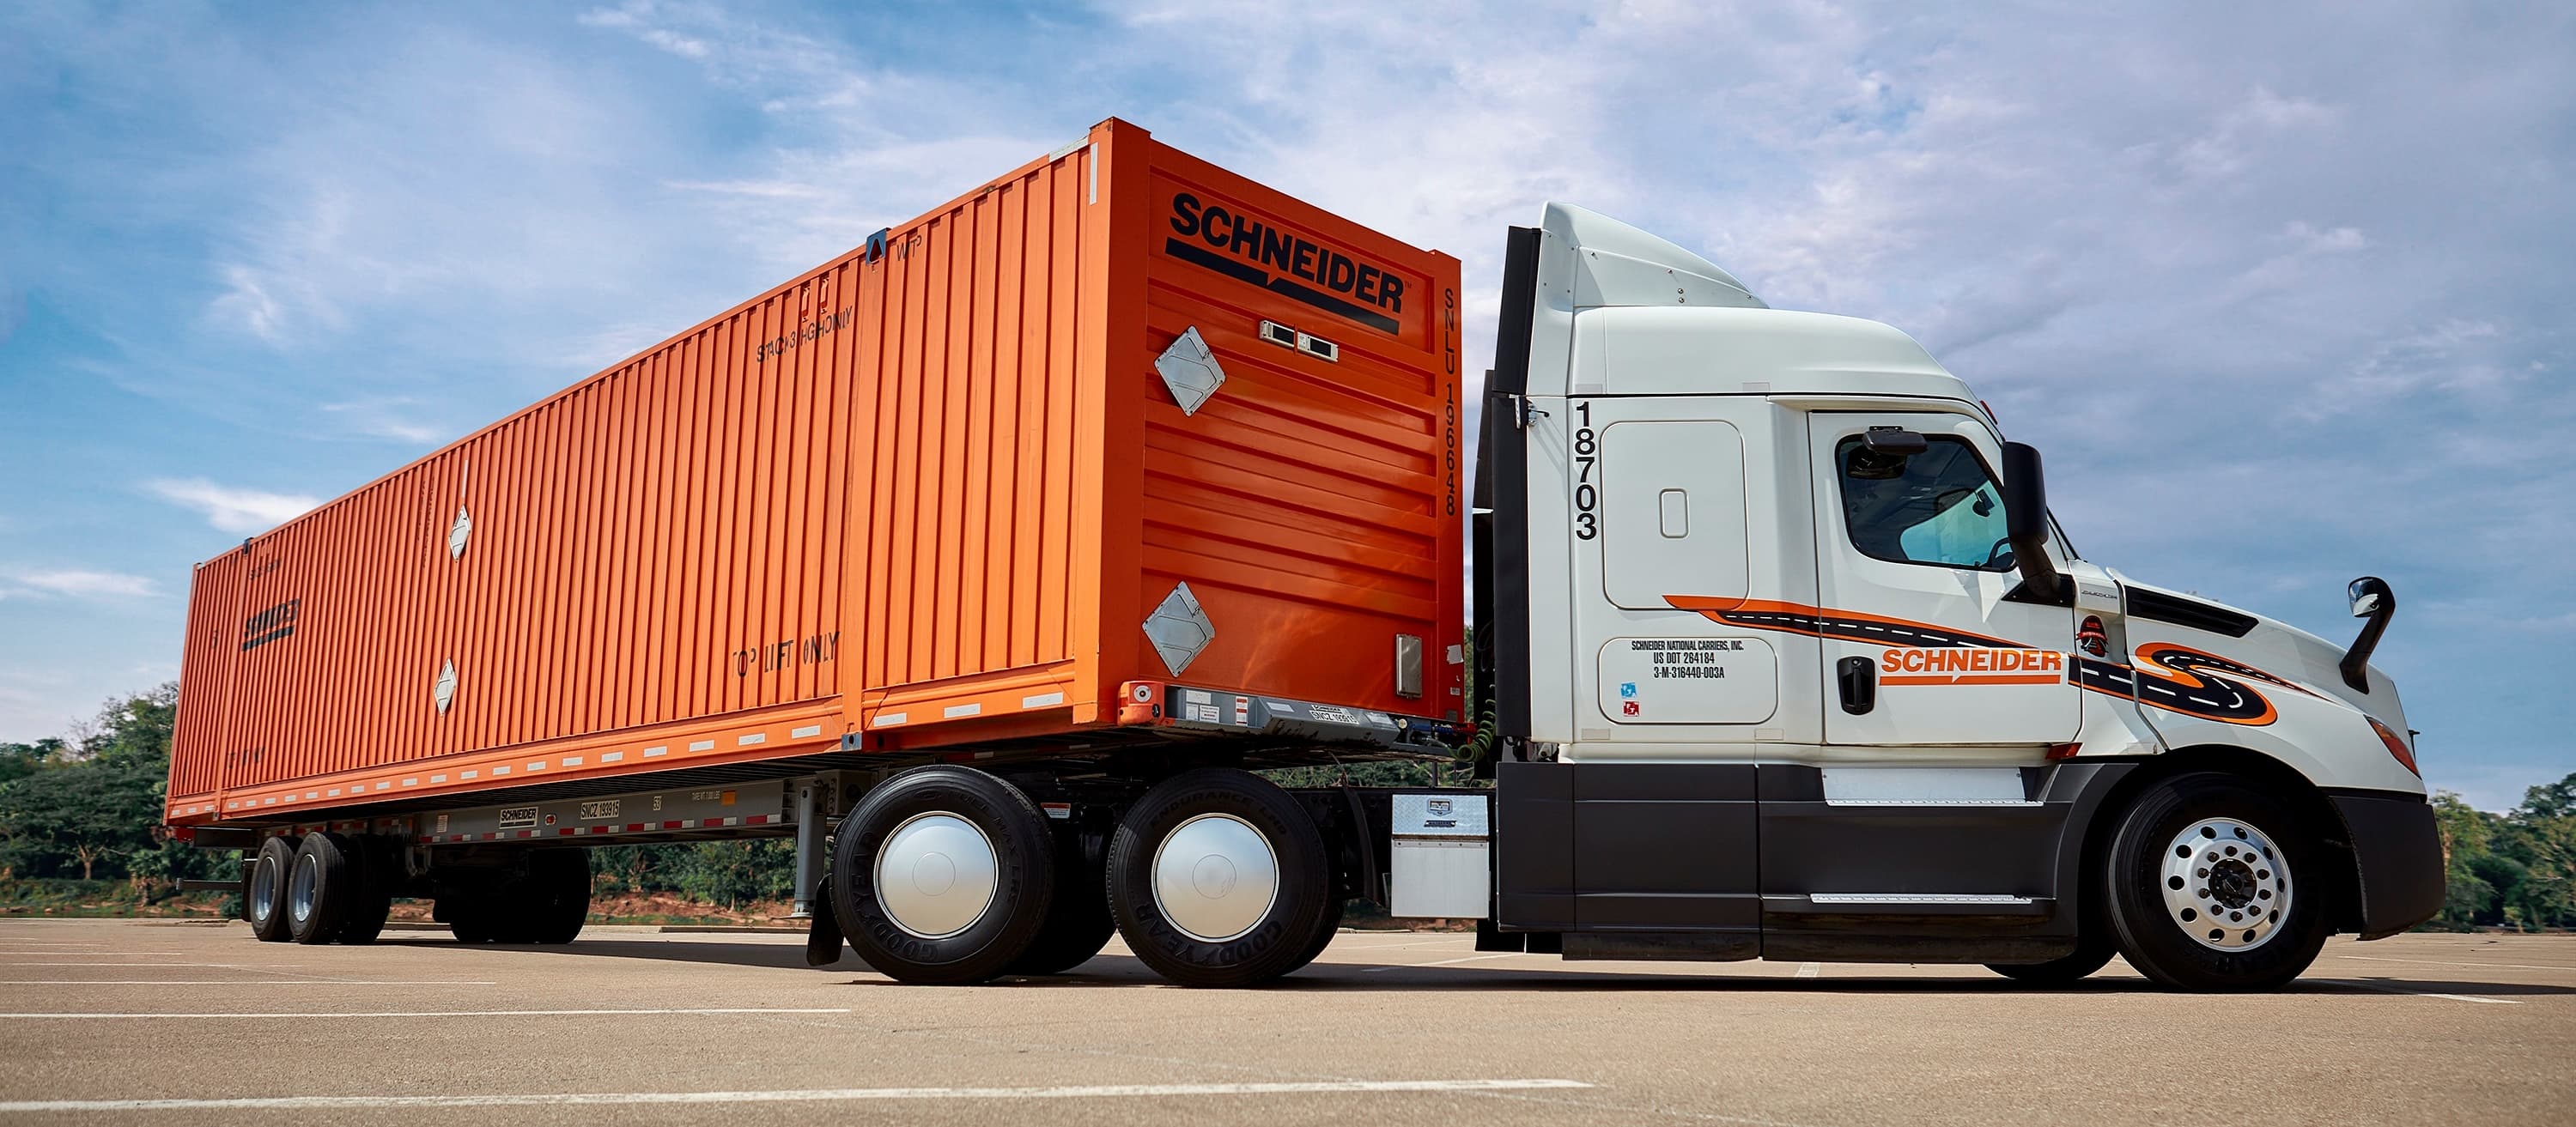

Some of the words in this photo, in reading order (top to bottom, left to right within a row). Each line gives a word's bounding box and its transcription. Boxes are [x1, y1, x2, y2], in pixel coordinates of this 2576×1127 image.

[1170, 192, 1405, 314] SCHNEIDER
[1444, 288, 1455, 375] SNLU
[1444, 383, 1455, 516] 196648
[1575, 401, 1597, 541] 18703
[764, 639, 794, 673] LIFT
[803, 631, 840, 664] ONLY
[1631, 640, 1666, 651] SCHNEIDER
[1667, 640, 1698, 651] NATIONAL
[1698, 640, 1730, 652] CARRIERS,
[1731, 640, 1745, 651] INC.
[1654, 652, 1664, 663] US
[1666, 652, 1681, 663] DOT
[1683, 652, 1715, 663] 264184
[1881, 649, 2061, 673] SCHNEIDER
[1654, 667, 1725, 679] 3-M-316440-003A
[501, 808, 537, 821] SCHNEIDER
[581, 803, 598, 818] SNCZ
[598, 801, 619, 816] 193915
[1149, 790, 1252, 828] ENDURANCE
[851, 831, 939, 962] GOODYEAR
[1134, 901, 1283, 962] GOODYEAR
